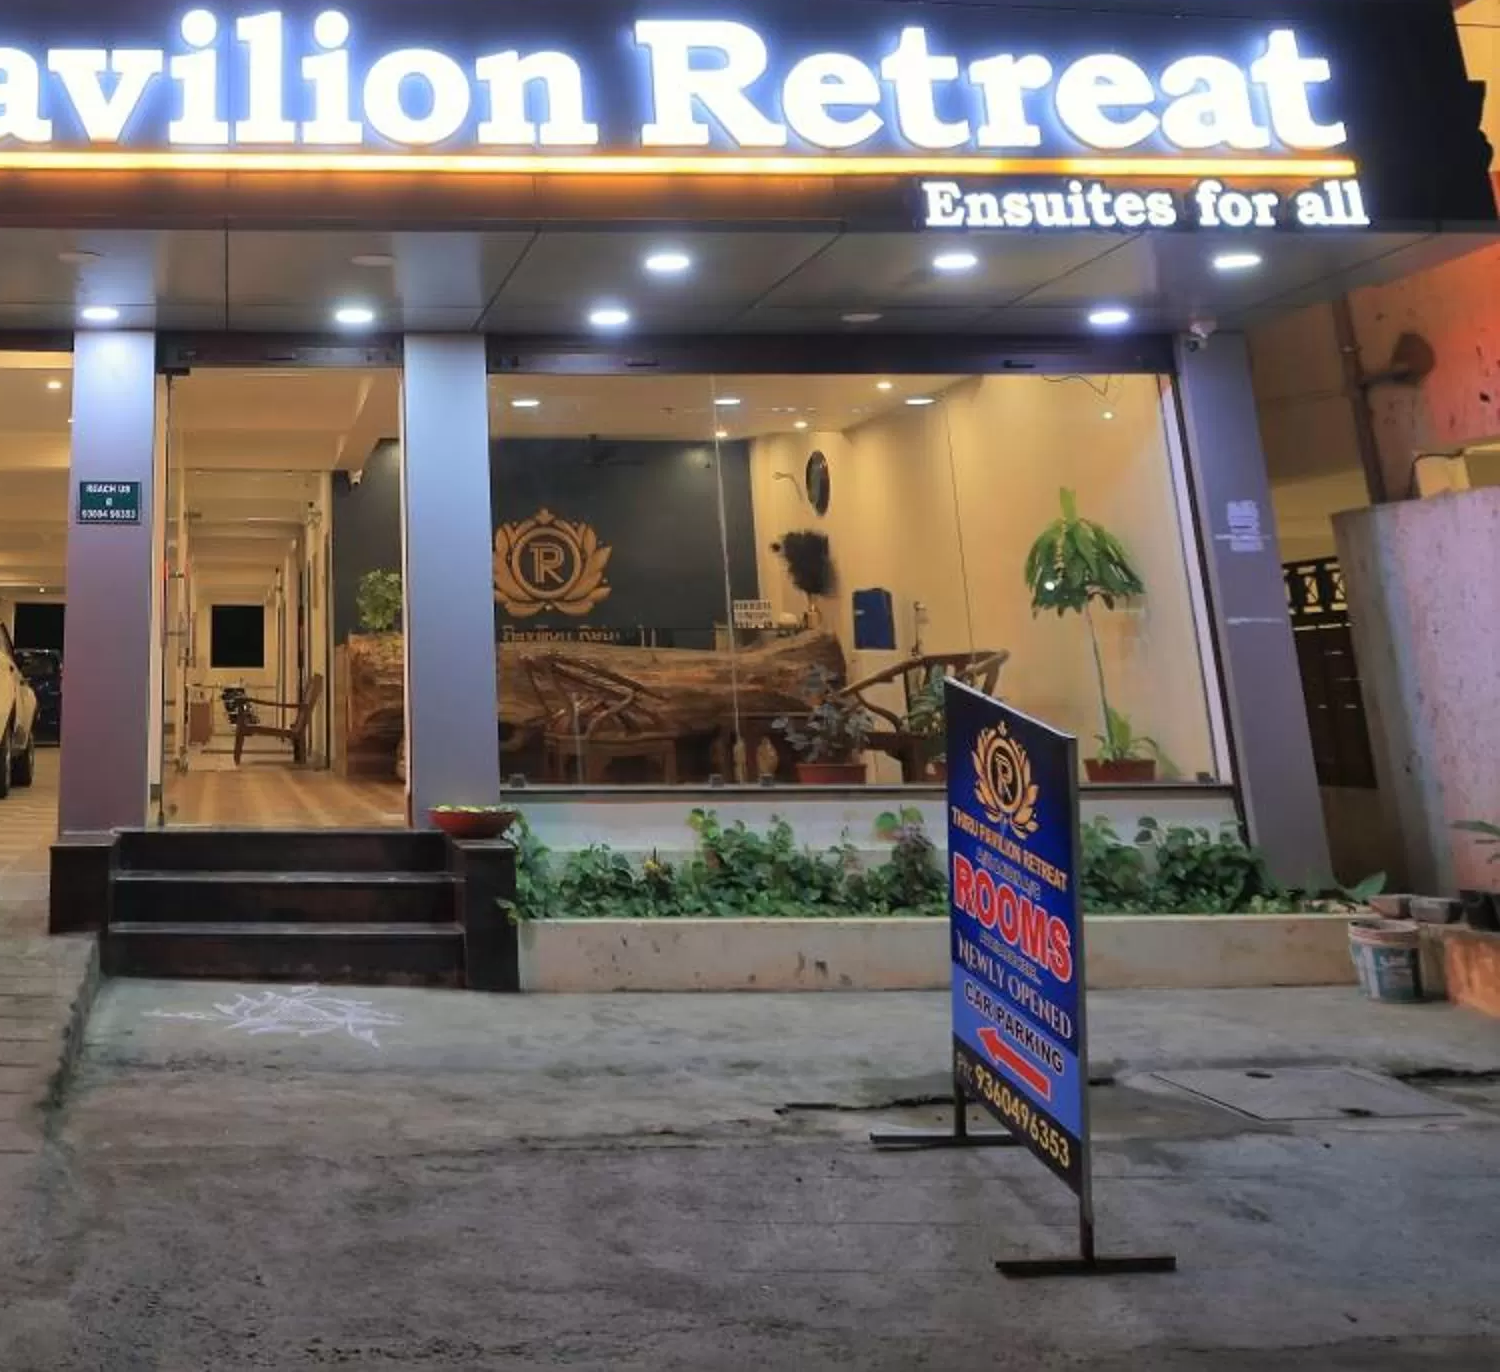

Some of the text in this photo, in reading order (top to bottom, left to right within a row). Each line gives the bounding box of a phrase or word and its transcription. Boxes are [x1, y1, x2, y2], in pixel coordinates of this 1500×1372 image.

[633, 18, 1347, 151] Retreat
[921, 179, 1371, 228] Ensuites for all
[950, 805, 980, 837] THIRU
[1022, 848, 1068, 892] RETREAT
[952, 851, 1073, 983] ROOMS
[956, 930, 1005, 989] NEWLY
[1007, 975, 1072, 1039] OPENED
[964, 979, 1066, 1077] CAR PARKING
[974, 1063, 1071, 1170] 9360496353
